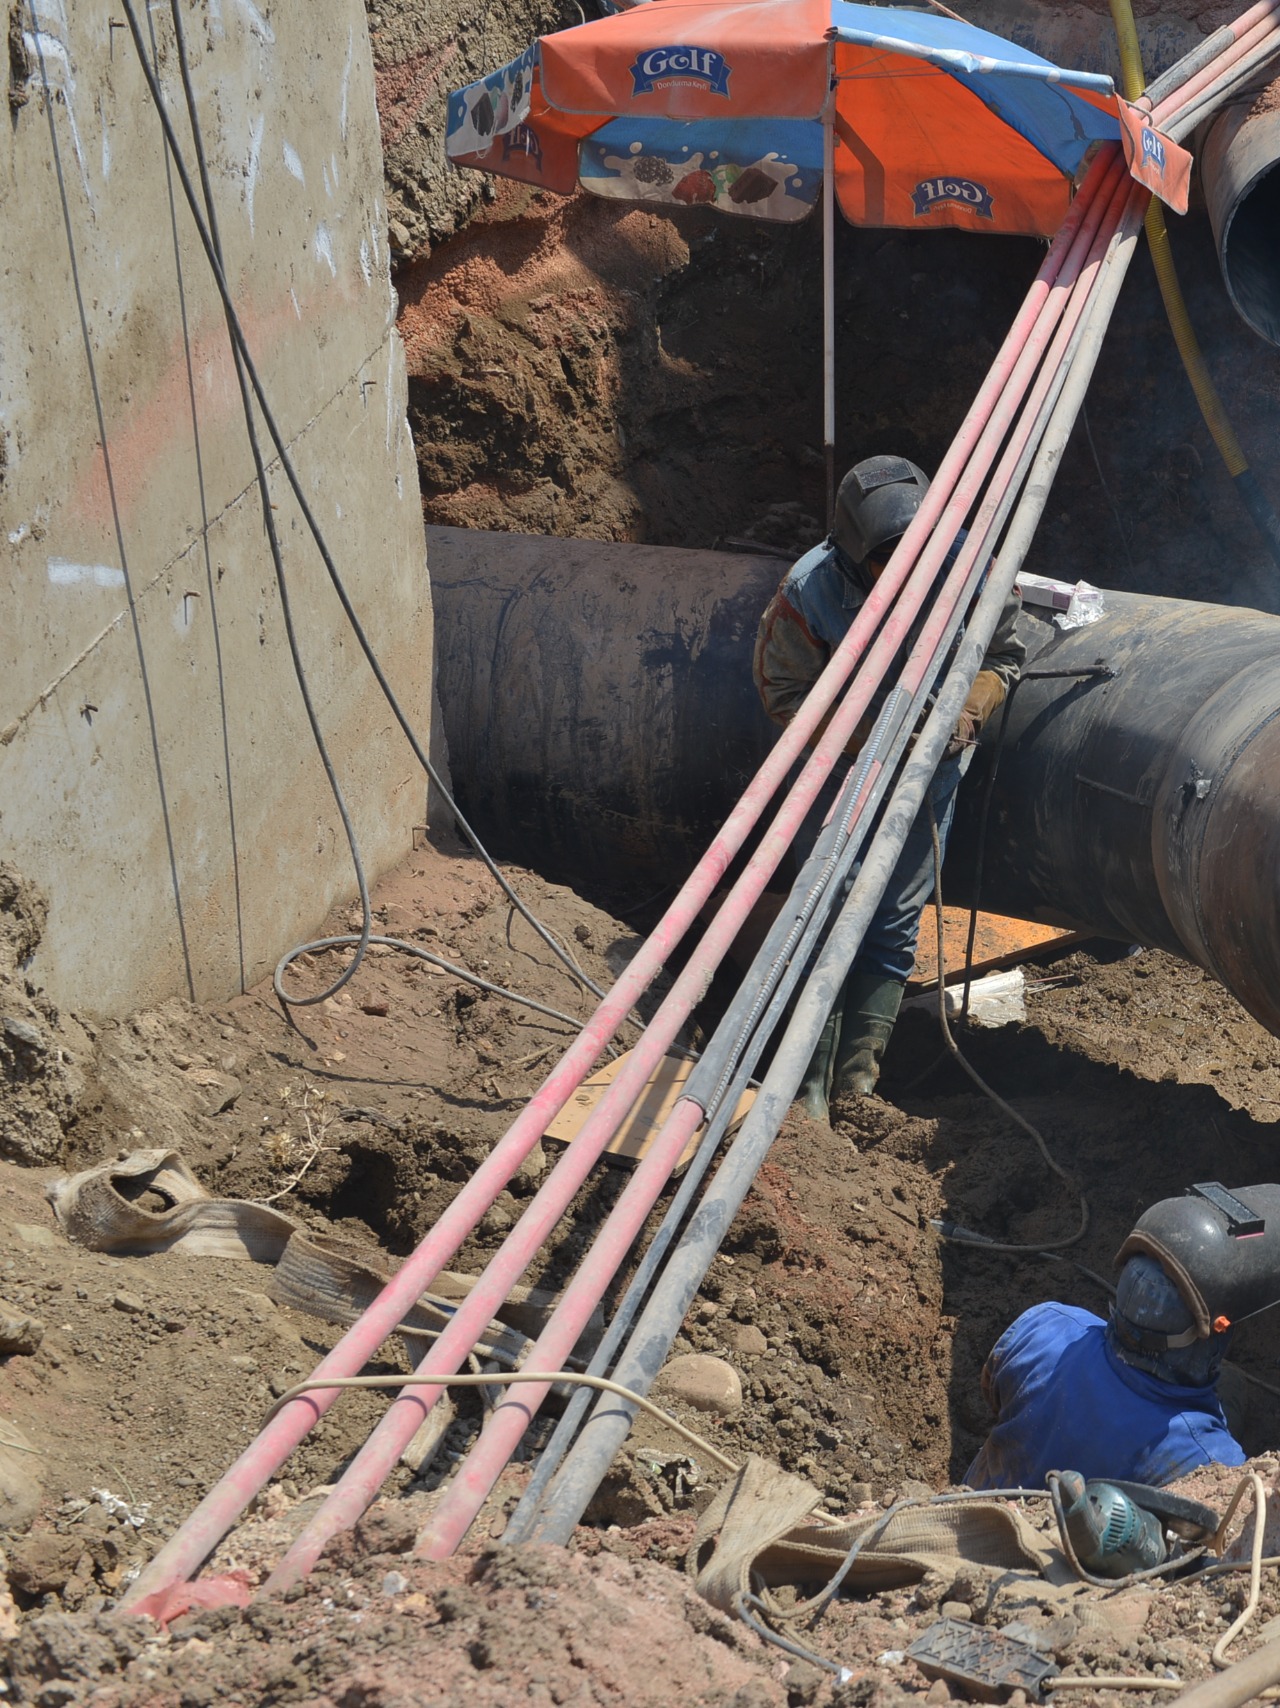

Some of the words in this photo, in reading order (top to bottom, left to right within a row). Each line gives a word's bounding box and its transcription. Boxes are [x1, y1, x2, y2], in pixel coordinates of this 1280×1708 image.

[643, 49, 717, 76] Golf
[656, 80, 692, 90] Dondurma
[1142, 130, 1163, 162] Golf
